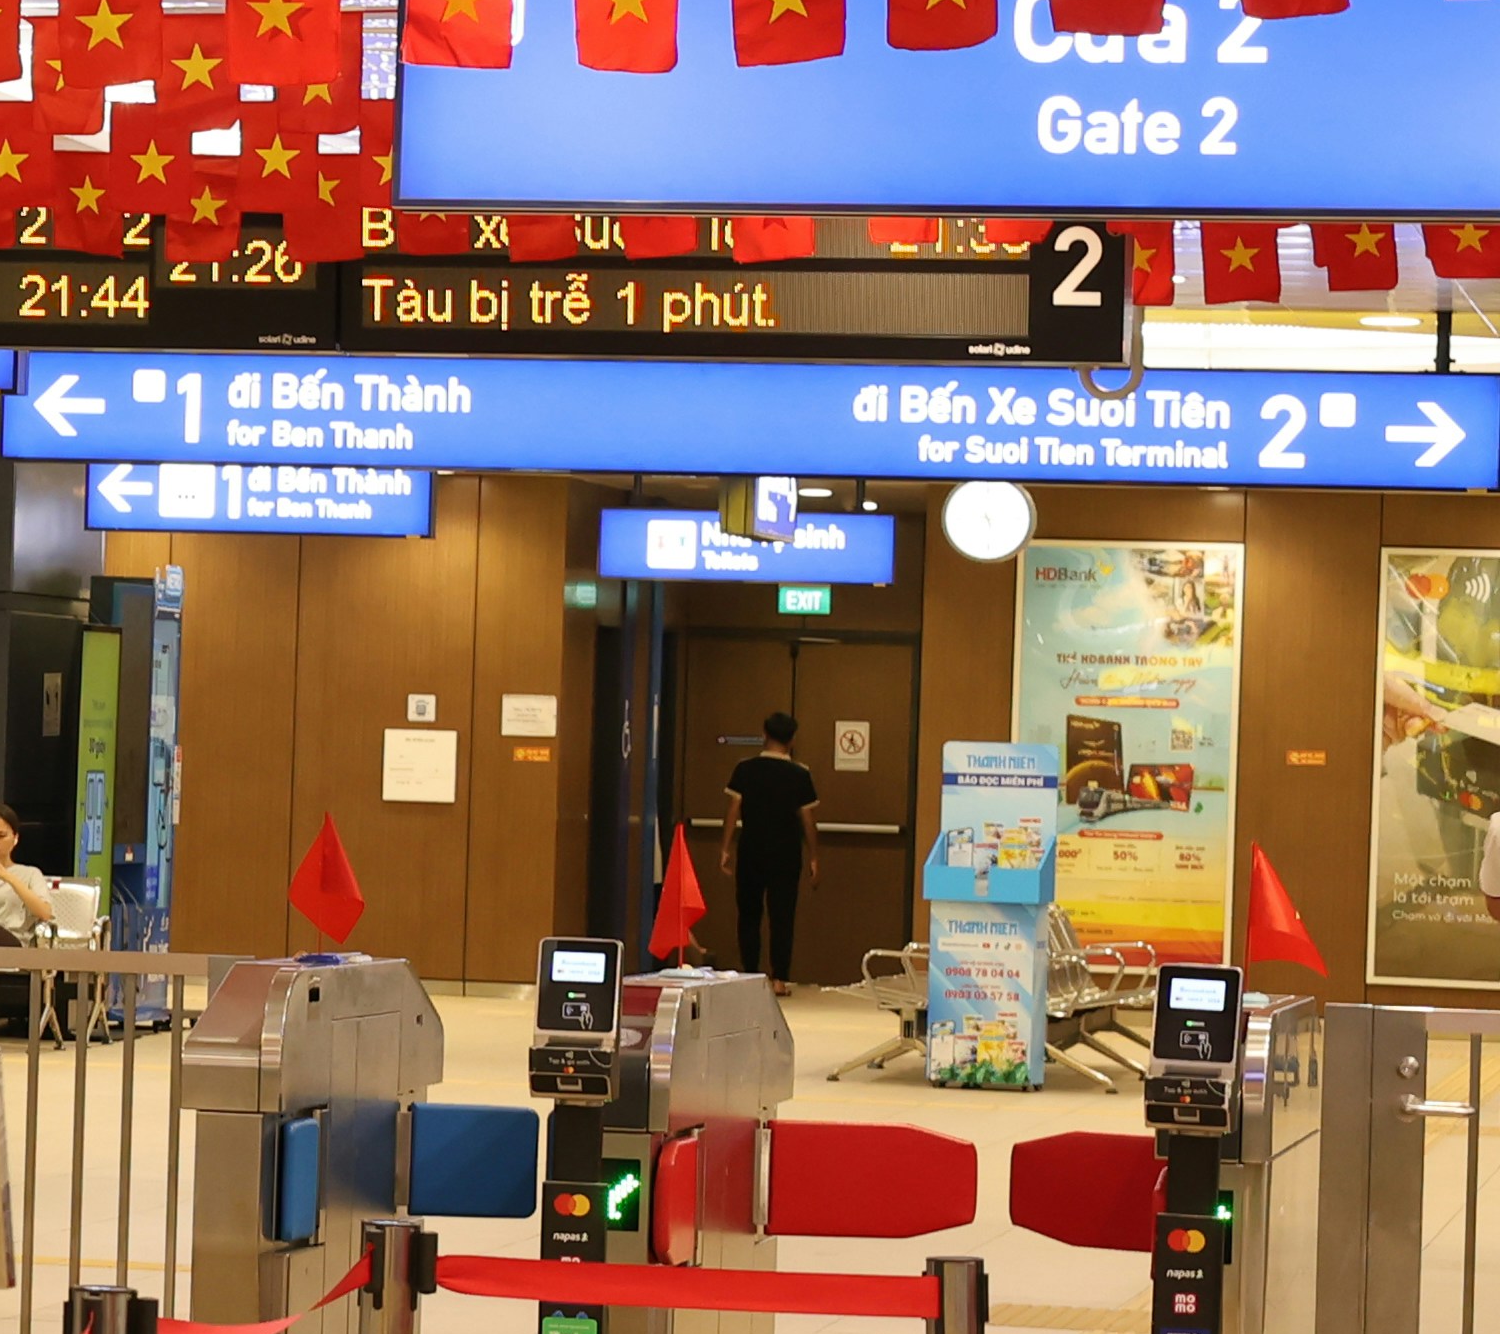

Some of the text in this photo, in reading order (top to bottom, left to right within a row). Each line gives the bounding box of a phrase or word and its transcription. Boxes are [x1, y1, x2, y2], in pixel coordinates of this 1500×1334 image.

[1037, 95, 1238, 155] Gate 2
[1052, 226, 1102, 307] 2
[19, 274, 150, 318] 21:44
[362, 273, 775, 333] Tàu bị trễ 1 phút.
[177, 368, 471, 444] 1 đi Bến Thành
[226, 419, 414, 450] for Ben Thanh
[852, 386, 888, 422] đi
[900, 380, 976, 424] Bến
[986, 387, 1037, 426] Xe
[1145, 390, 1231, 430] Tiên
[1258, 393, 1307, 469] 2
[918, 435, 1228, 468] for Suoi Tien Terminal
[1035, 567, 1098, 581] HDBank
[785, 590, 823, 610] EXIT
[1394, 873, 1472, 889] Một chạm
[1393, 889, 1407, 903] là
[1435, 893, 1474, 906] trạm
[553, 1232, 581, 1243] napas
[1166, 1268, 1196, 1279] napas
